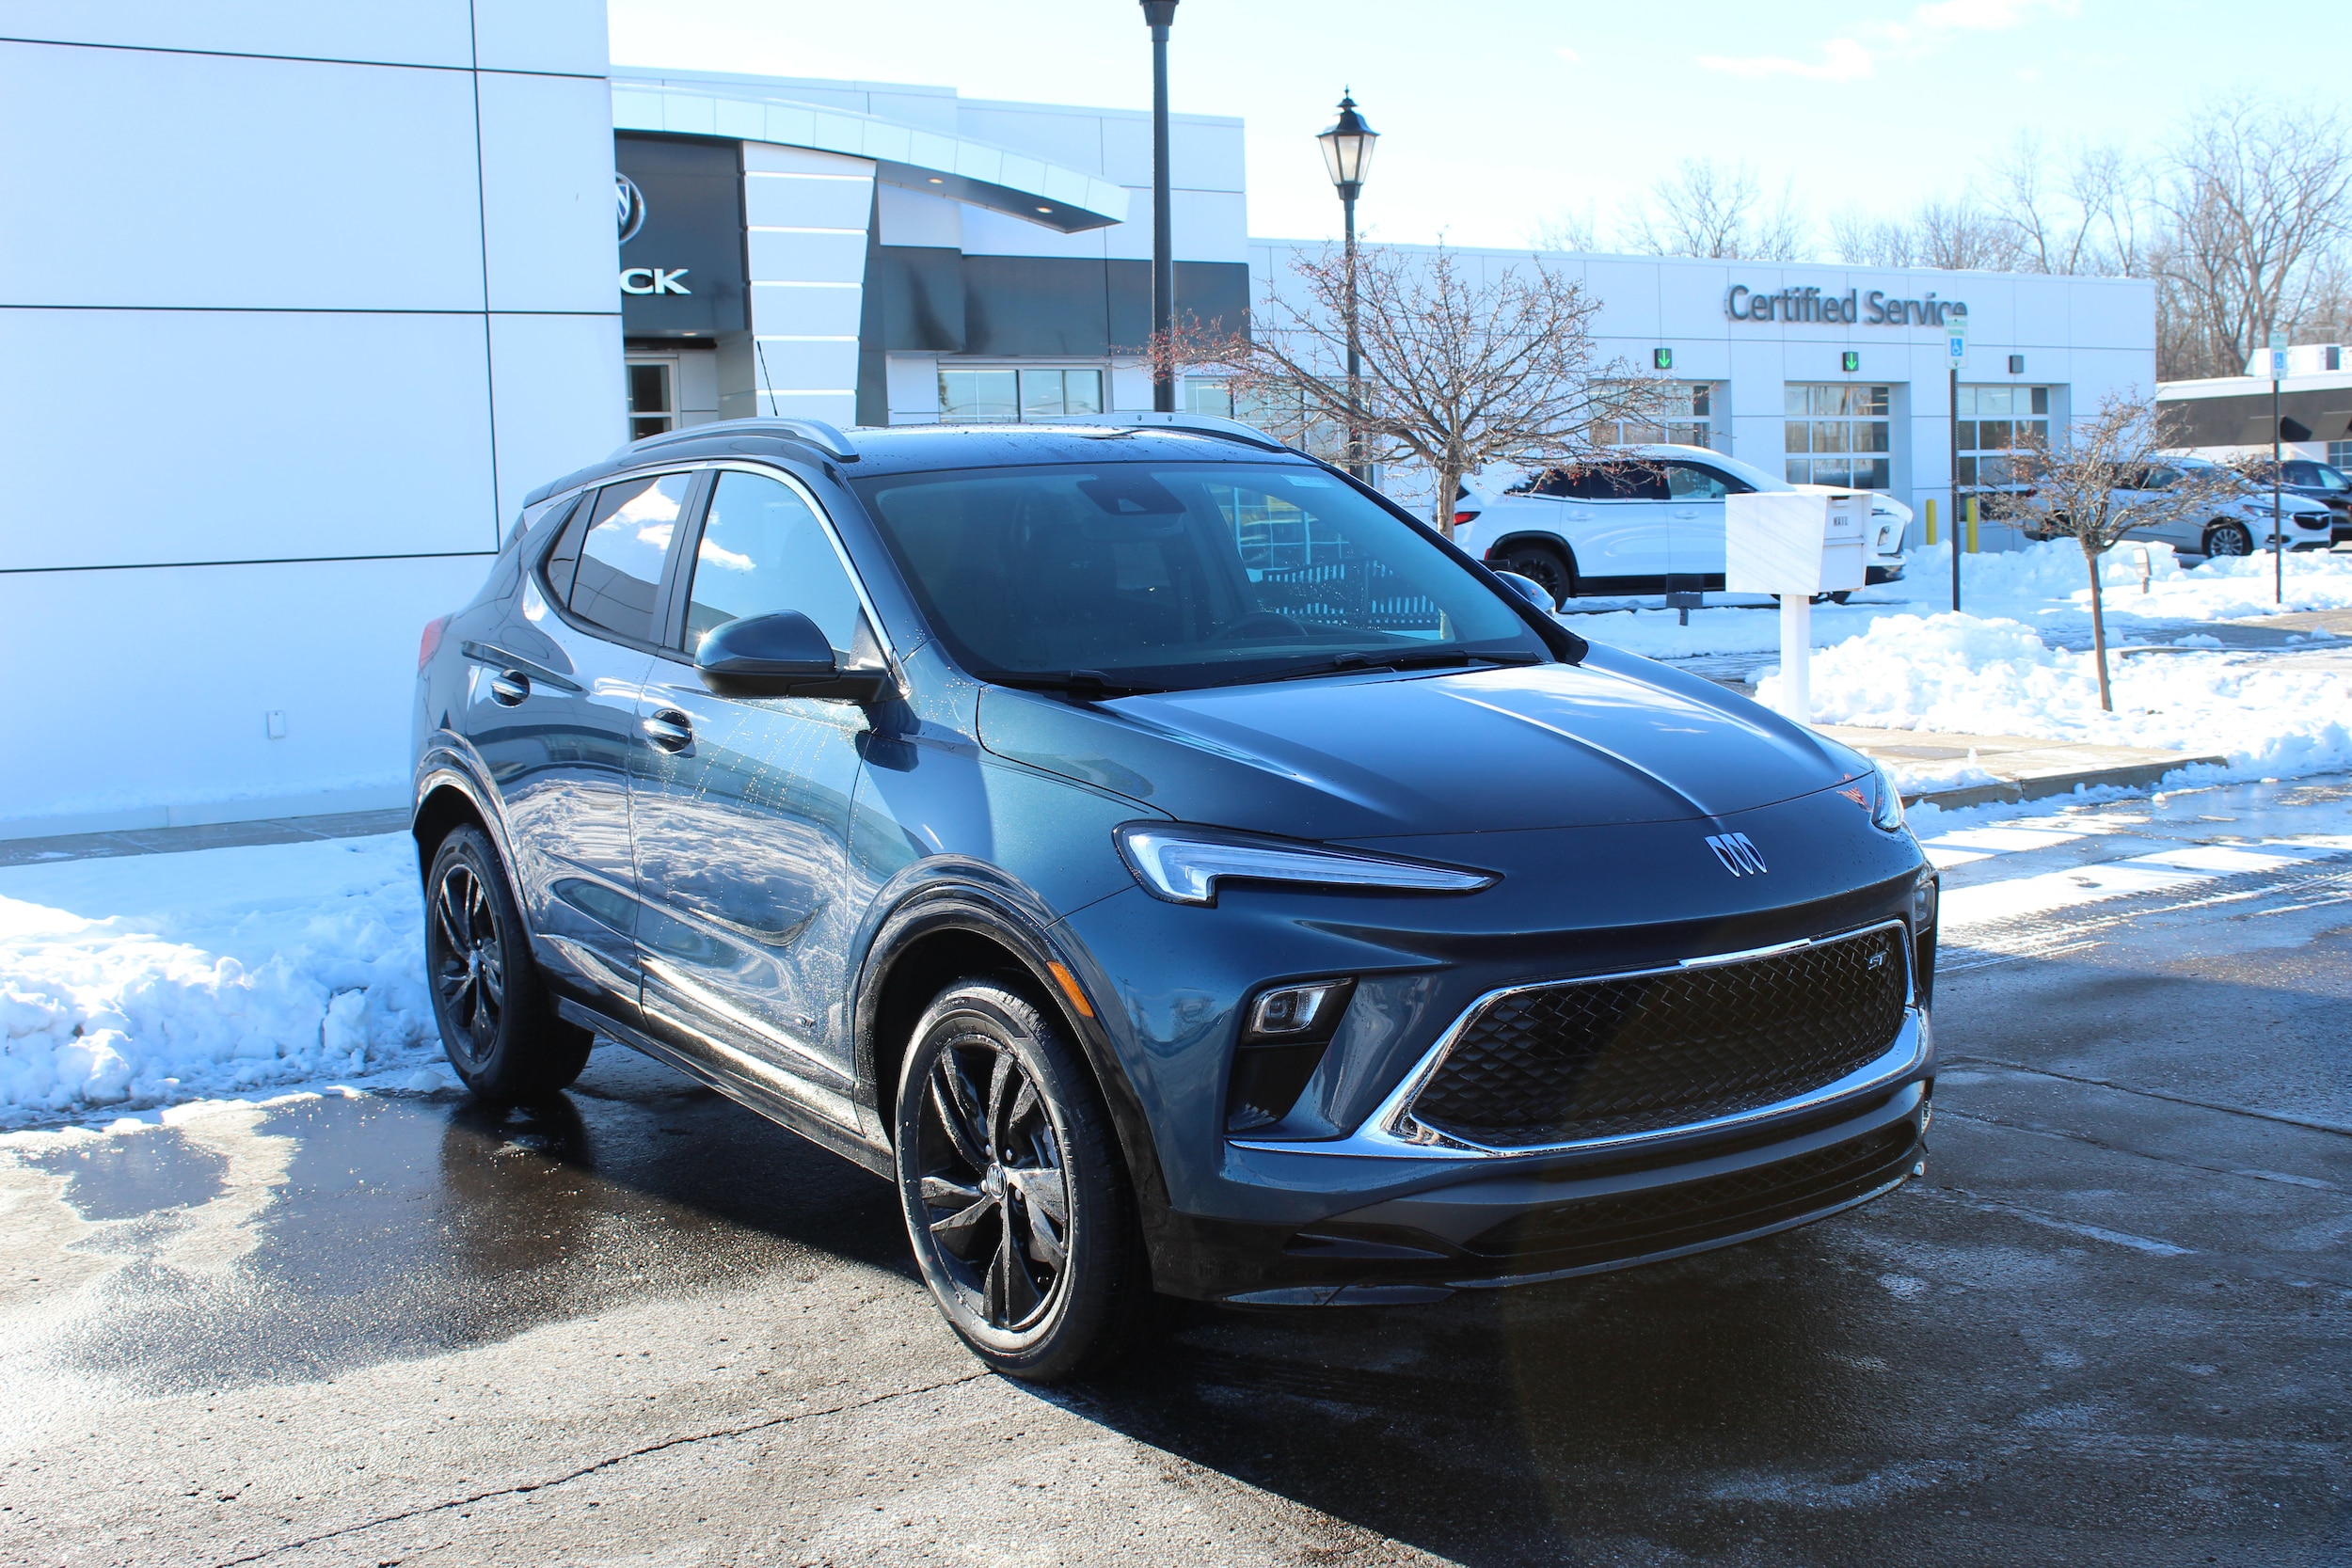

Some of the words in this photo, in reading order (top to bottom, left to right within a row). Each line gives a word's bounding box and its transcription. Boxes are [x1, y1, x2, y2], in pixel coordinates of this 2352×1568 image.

[1725, 284, 1857, 325] Certified
[1864, 290, 1968, 326] Service
[1833, 515, 1849, 527] MAIL
